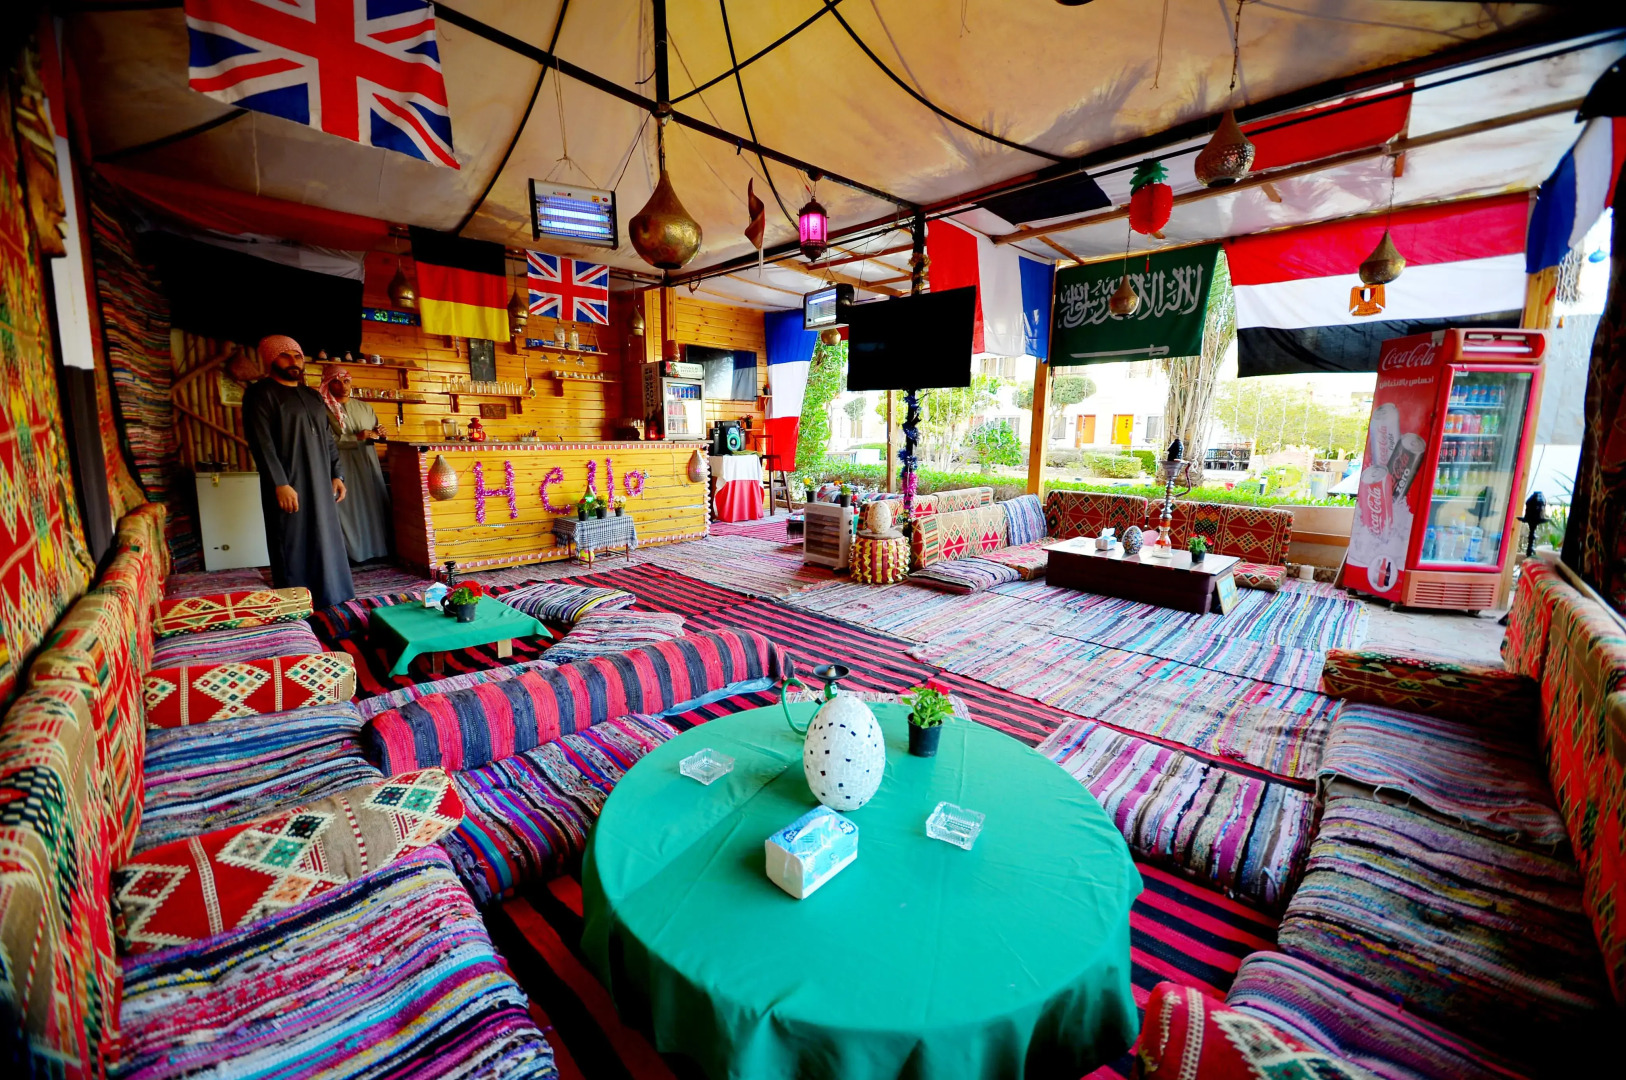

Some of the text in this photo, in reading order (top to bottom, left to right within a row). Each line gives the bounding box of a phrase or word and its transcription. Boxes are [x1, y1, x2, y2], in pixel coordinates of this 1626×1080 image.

[1381, 342, 1436, 371] Coca-Cola
[473, 457, 645, 524] Hello
[1395, 467, 1411, 493] zero
